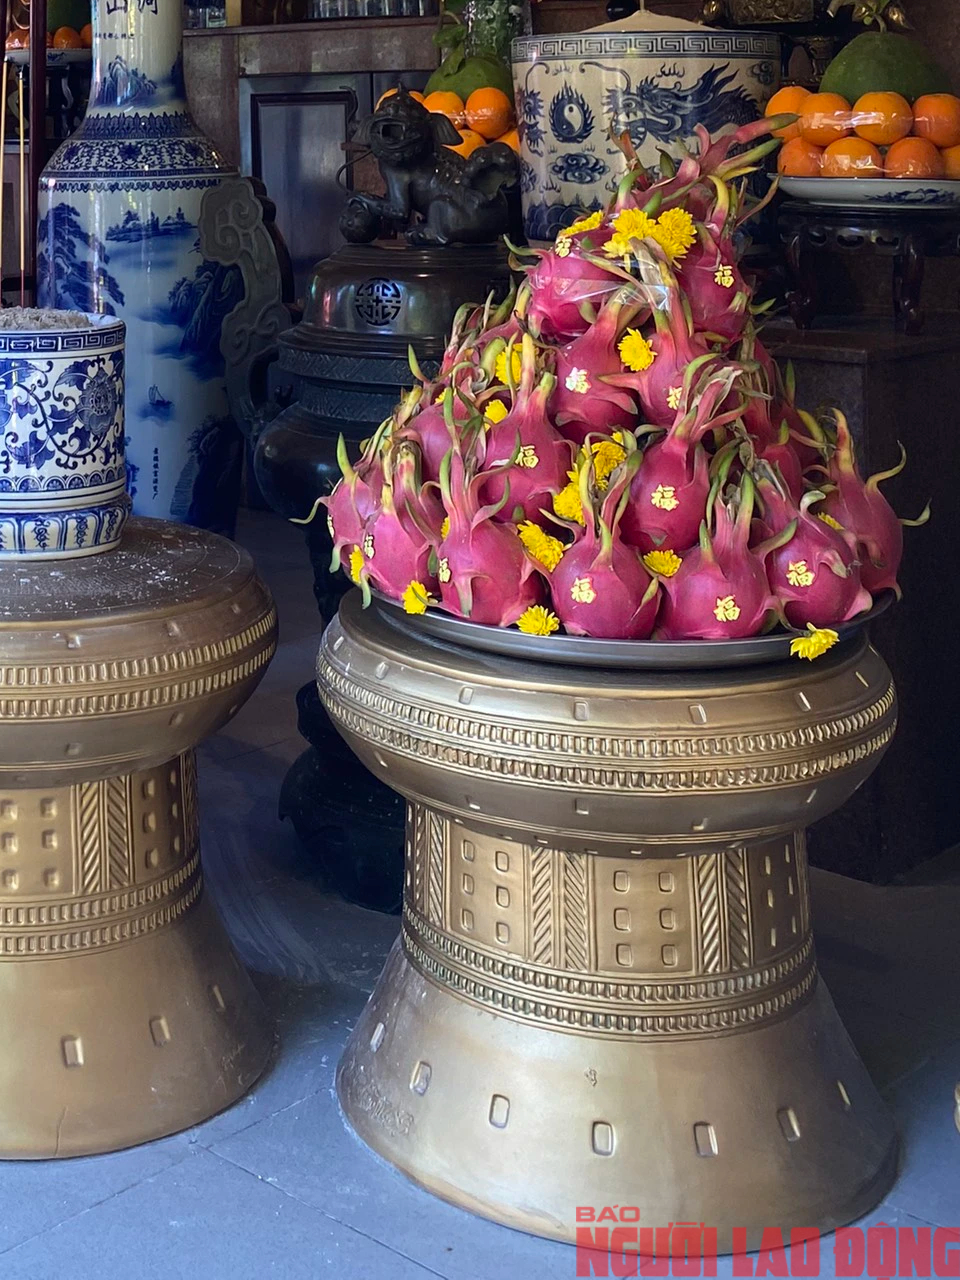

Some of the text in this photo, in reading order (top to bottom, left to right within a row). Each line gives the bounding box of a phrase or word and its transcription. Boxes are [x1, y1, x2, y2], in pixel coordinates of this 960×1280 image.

[714, 264, 734, 288] 福
[565, 367, 591, 394] 福
[515, 445, 539, 469] 福
[651, 484, 680, 511] 福
[786, 559, 815, 587] 福
[571, 577, 597, 604] 福
[713, 595, 740, 622] 福
